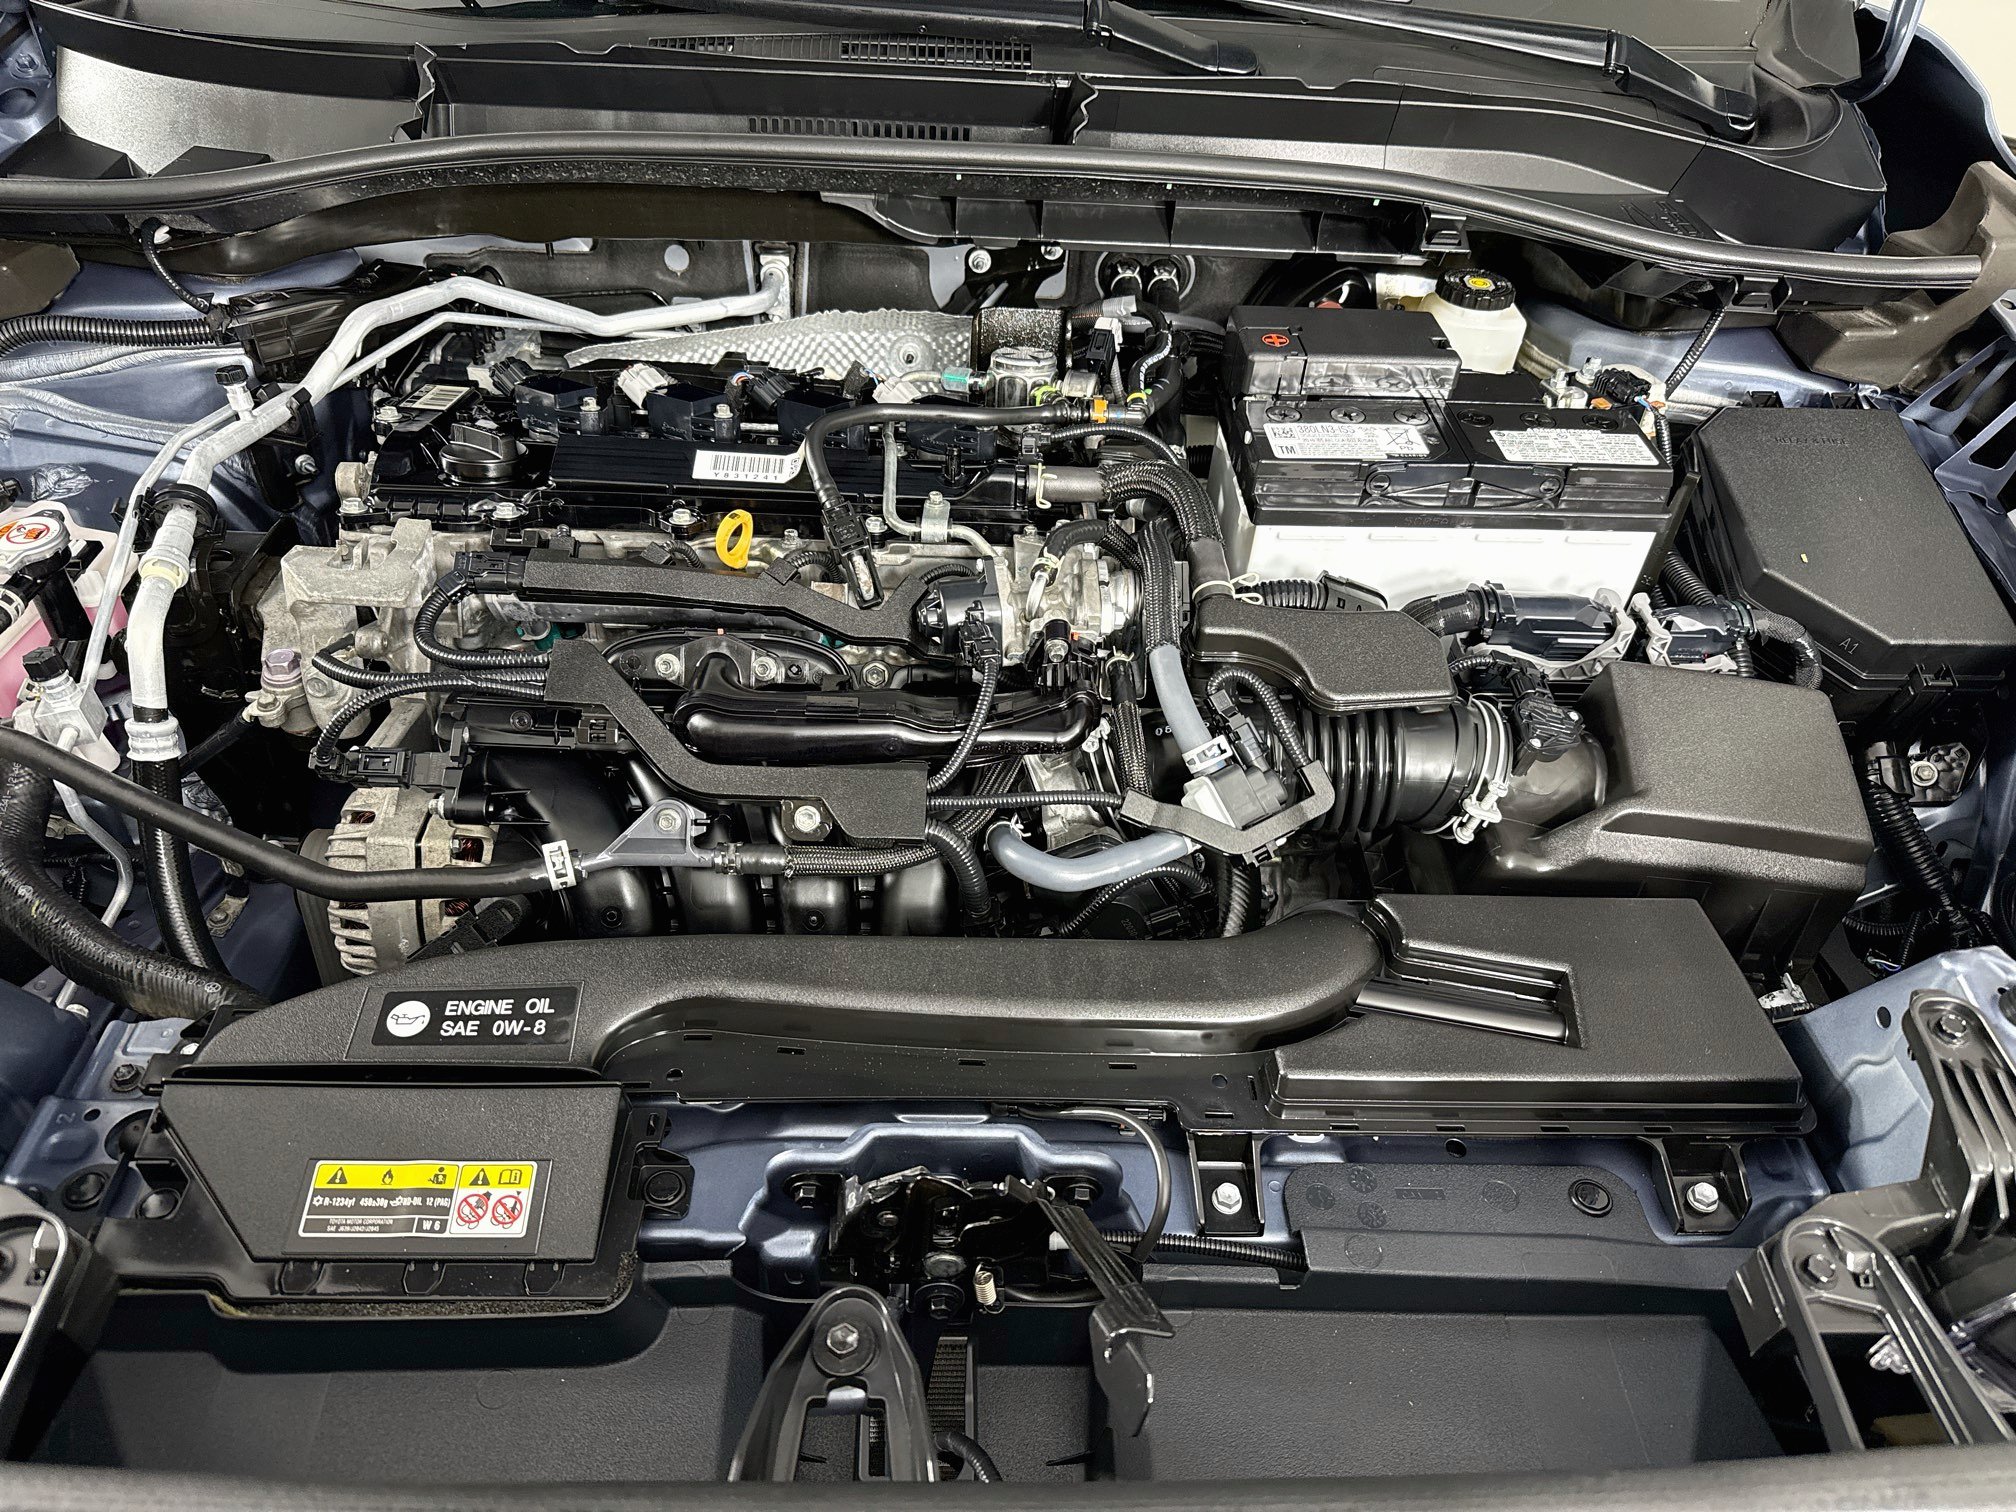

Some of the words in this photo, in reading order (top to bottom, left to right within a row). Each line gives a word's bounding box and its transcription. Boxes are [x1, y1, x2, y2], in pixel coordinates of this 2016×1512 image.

[1278, 445, 1296, 455] TM
[1839, 637, 1859, 655] A1
[444, 999, 515, 1016] ENGINE
[525, 997, 556, 1015] OIL
[440, 1020, 480, 1037] SAE
[492, 1019, 547, 1036] 0W-8
[426, 1196, 434, 1206] 12
[434, 1197, 451, 1208] (PAG)
[422, 1220, 432, 1231] W
[433, 1220, 441, 1231] 6
